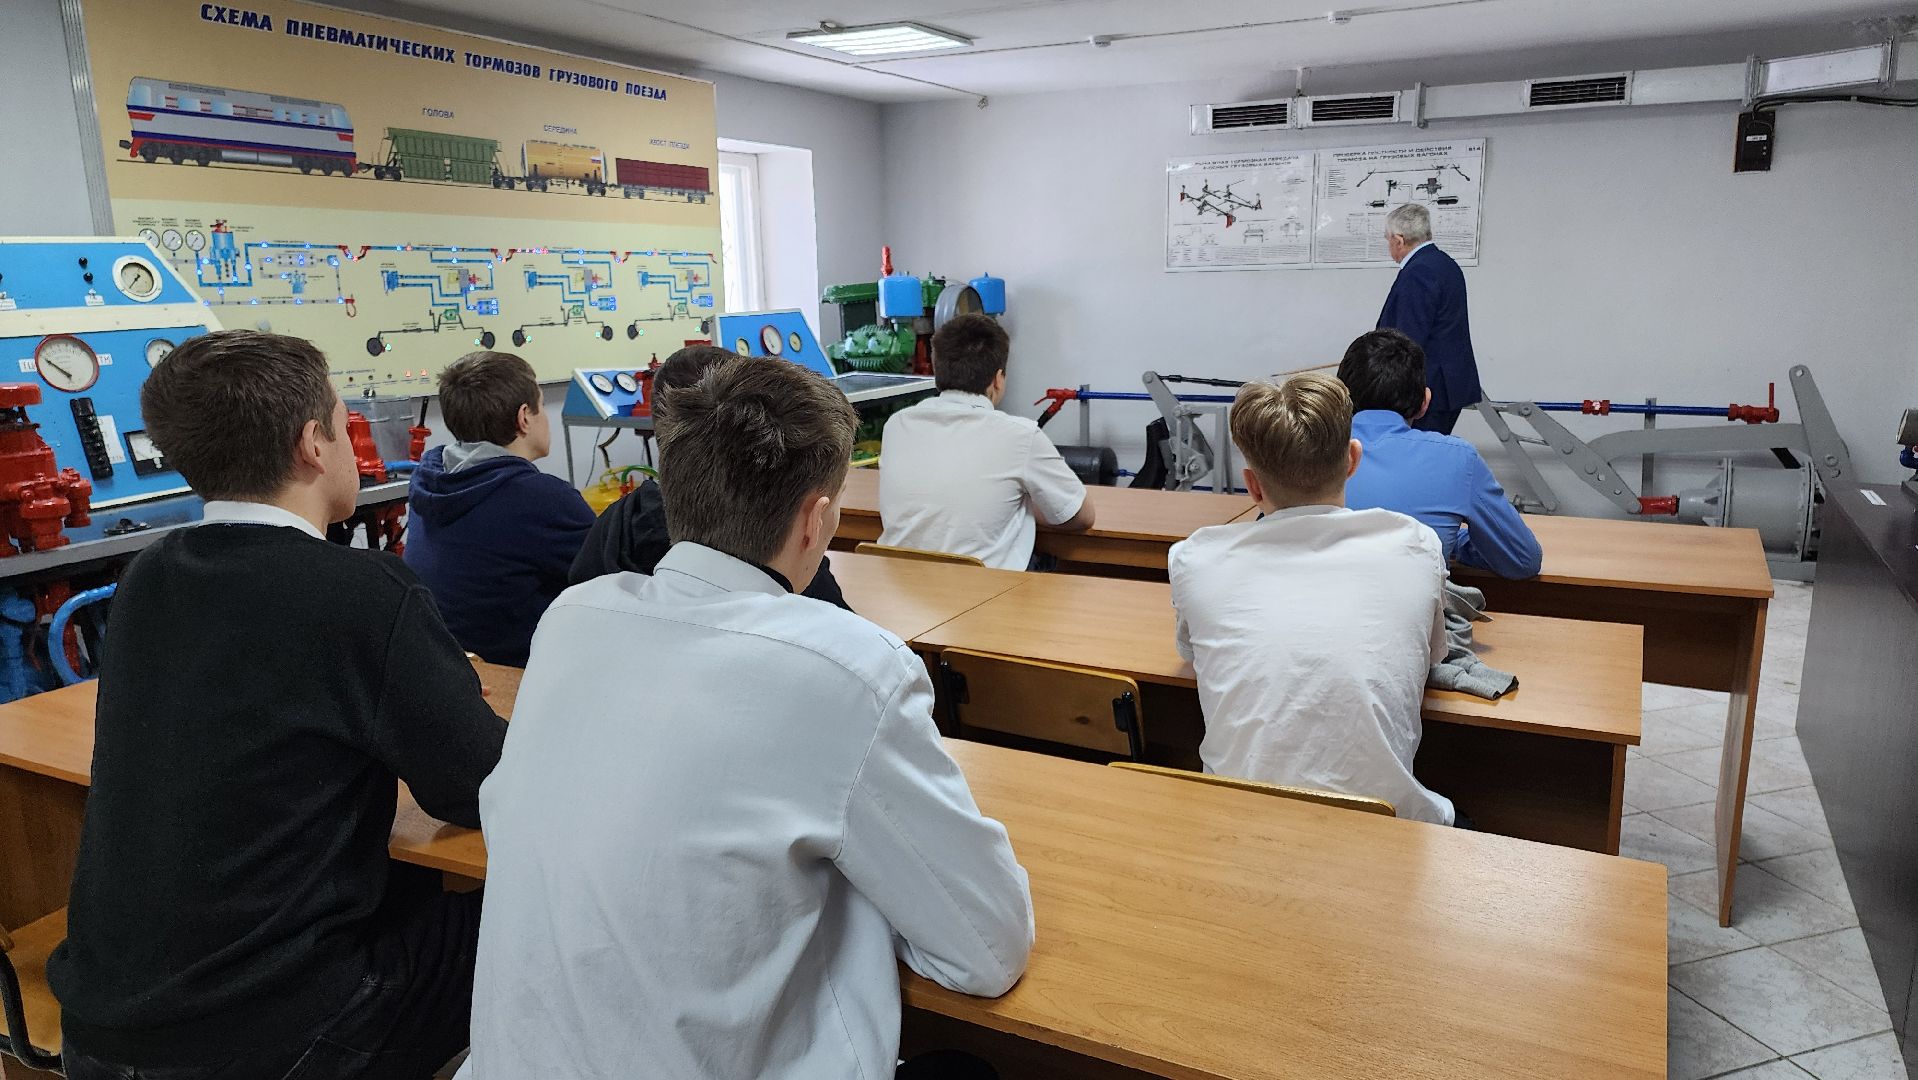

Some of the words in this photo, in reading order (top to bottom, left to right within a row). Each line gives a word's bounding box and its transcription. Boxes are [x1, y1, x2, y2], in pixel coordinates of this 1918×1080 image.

[200, 3, 273, 32] СХЕМА
[286, 19, 456, 64] ПНЕВМАТИЧЕСКИХ
[464, 52, 541, 79] ТОРМОЗОВ
[549, 68, 619, 93] ГРУЗОВОГО
[625, 82, 667, 101] ПОЕЗДА
[421, 107, 455, 120] ГОЛОВА
[543, 124, 578, 135] СЕРЕДИНА
